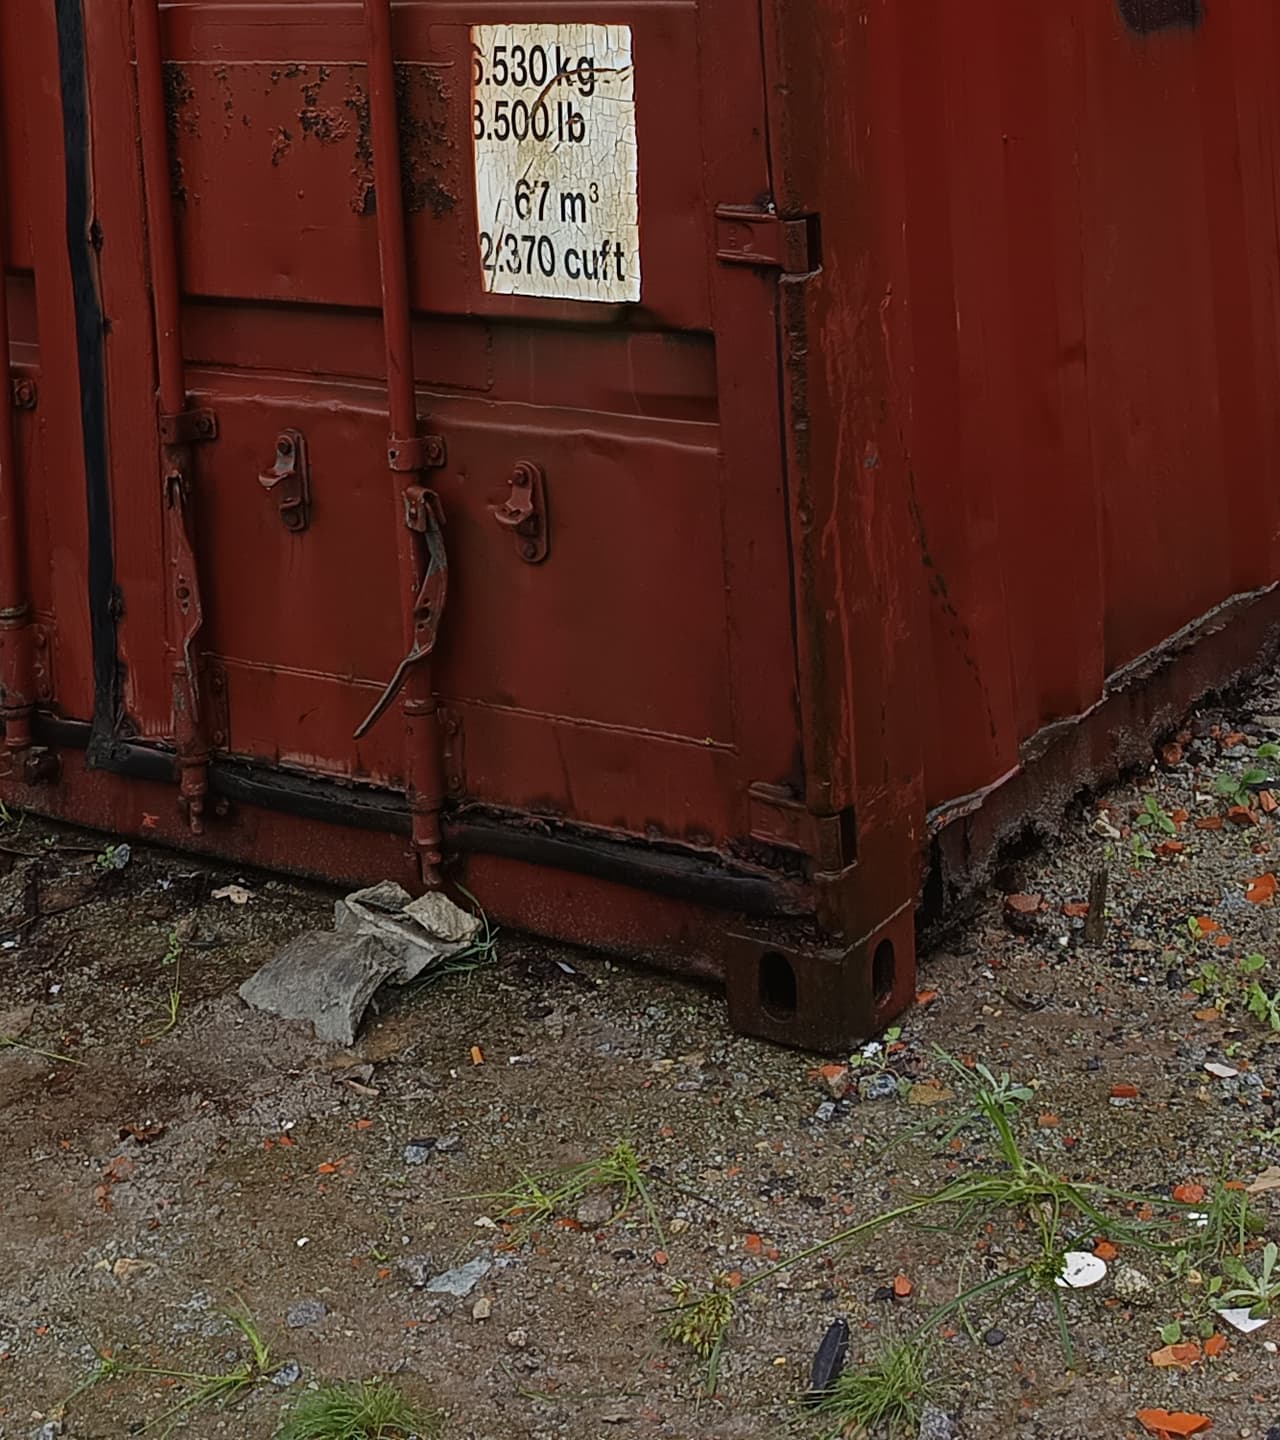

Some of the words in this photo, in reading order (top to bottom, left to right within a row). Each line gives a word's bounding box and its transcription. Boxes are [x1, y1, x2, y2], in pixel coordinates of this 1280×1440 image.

[555, 45, 595, 97] kg
[557, 100, 586, 143] lb
[514, 178, 550, 221] 67
